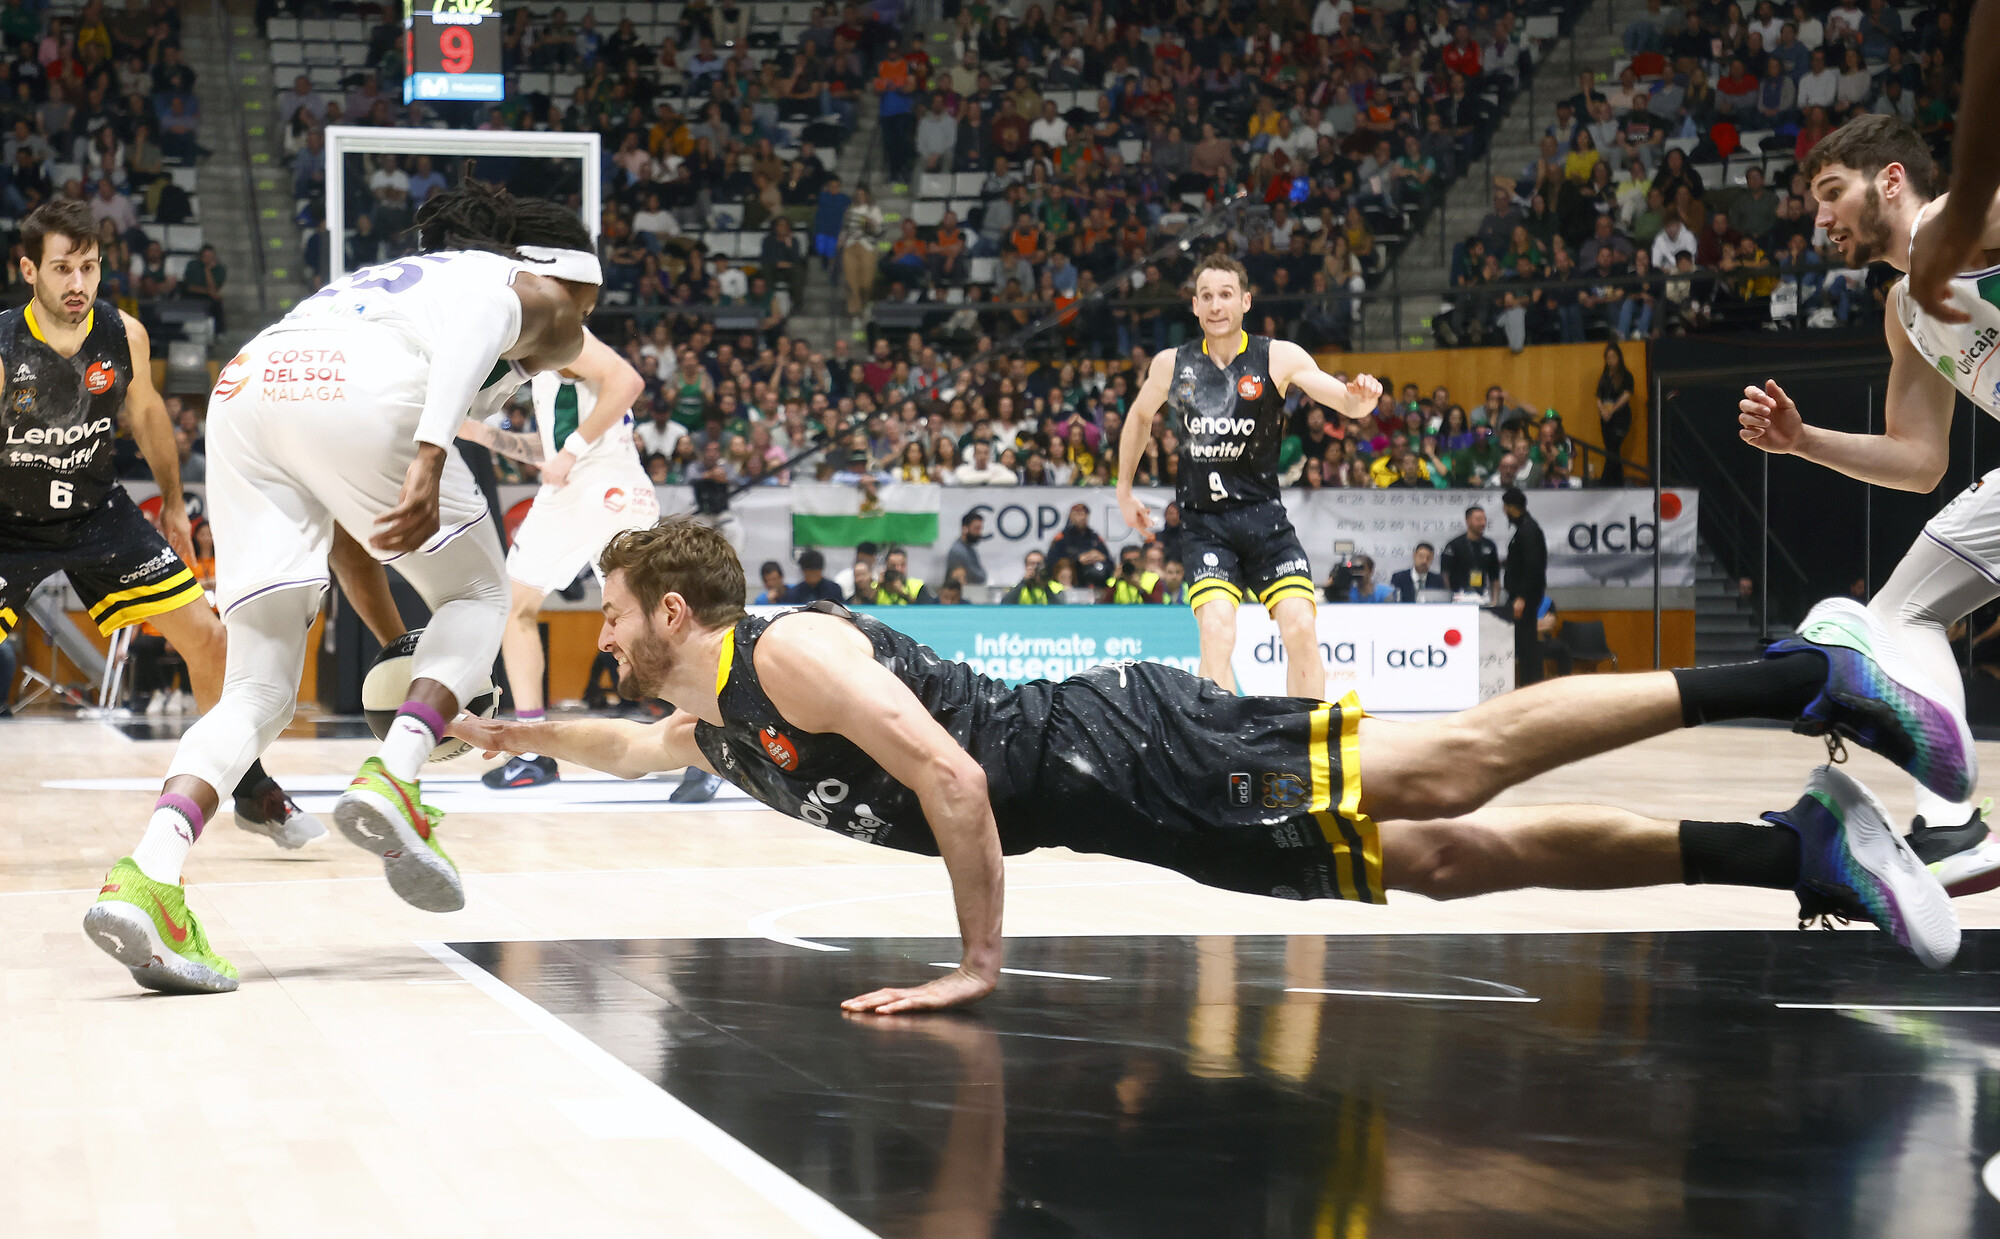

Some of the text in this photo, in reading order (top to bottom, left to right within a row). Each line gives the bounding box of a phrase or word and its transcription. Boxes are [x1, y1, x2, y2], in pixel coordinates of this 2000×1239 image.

[440, 26, 474, 74] 9
[267, 350, 346, 364] COSTA
[1957, 326, 2000, 375] Unicaja
[262, 367, 346, 383] DEL SOL
[261, 383, 346, 402] MÁLAGA
[5, 416, 112, 446] Lenovo
[1183, 413, 1256, 437] Lenovo
[50, 479, 74, 510] 6
[1208, 471, 1229, 502] 9
[1568, 515, 1656, 552] acb
[974, 632, 1097, 657] Infórmate
[1254, 635, 1354, 664] dina
[1386, 644, 1448, 669] acb
[1238, 781, 1249, 804] acb
